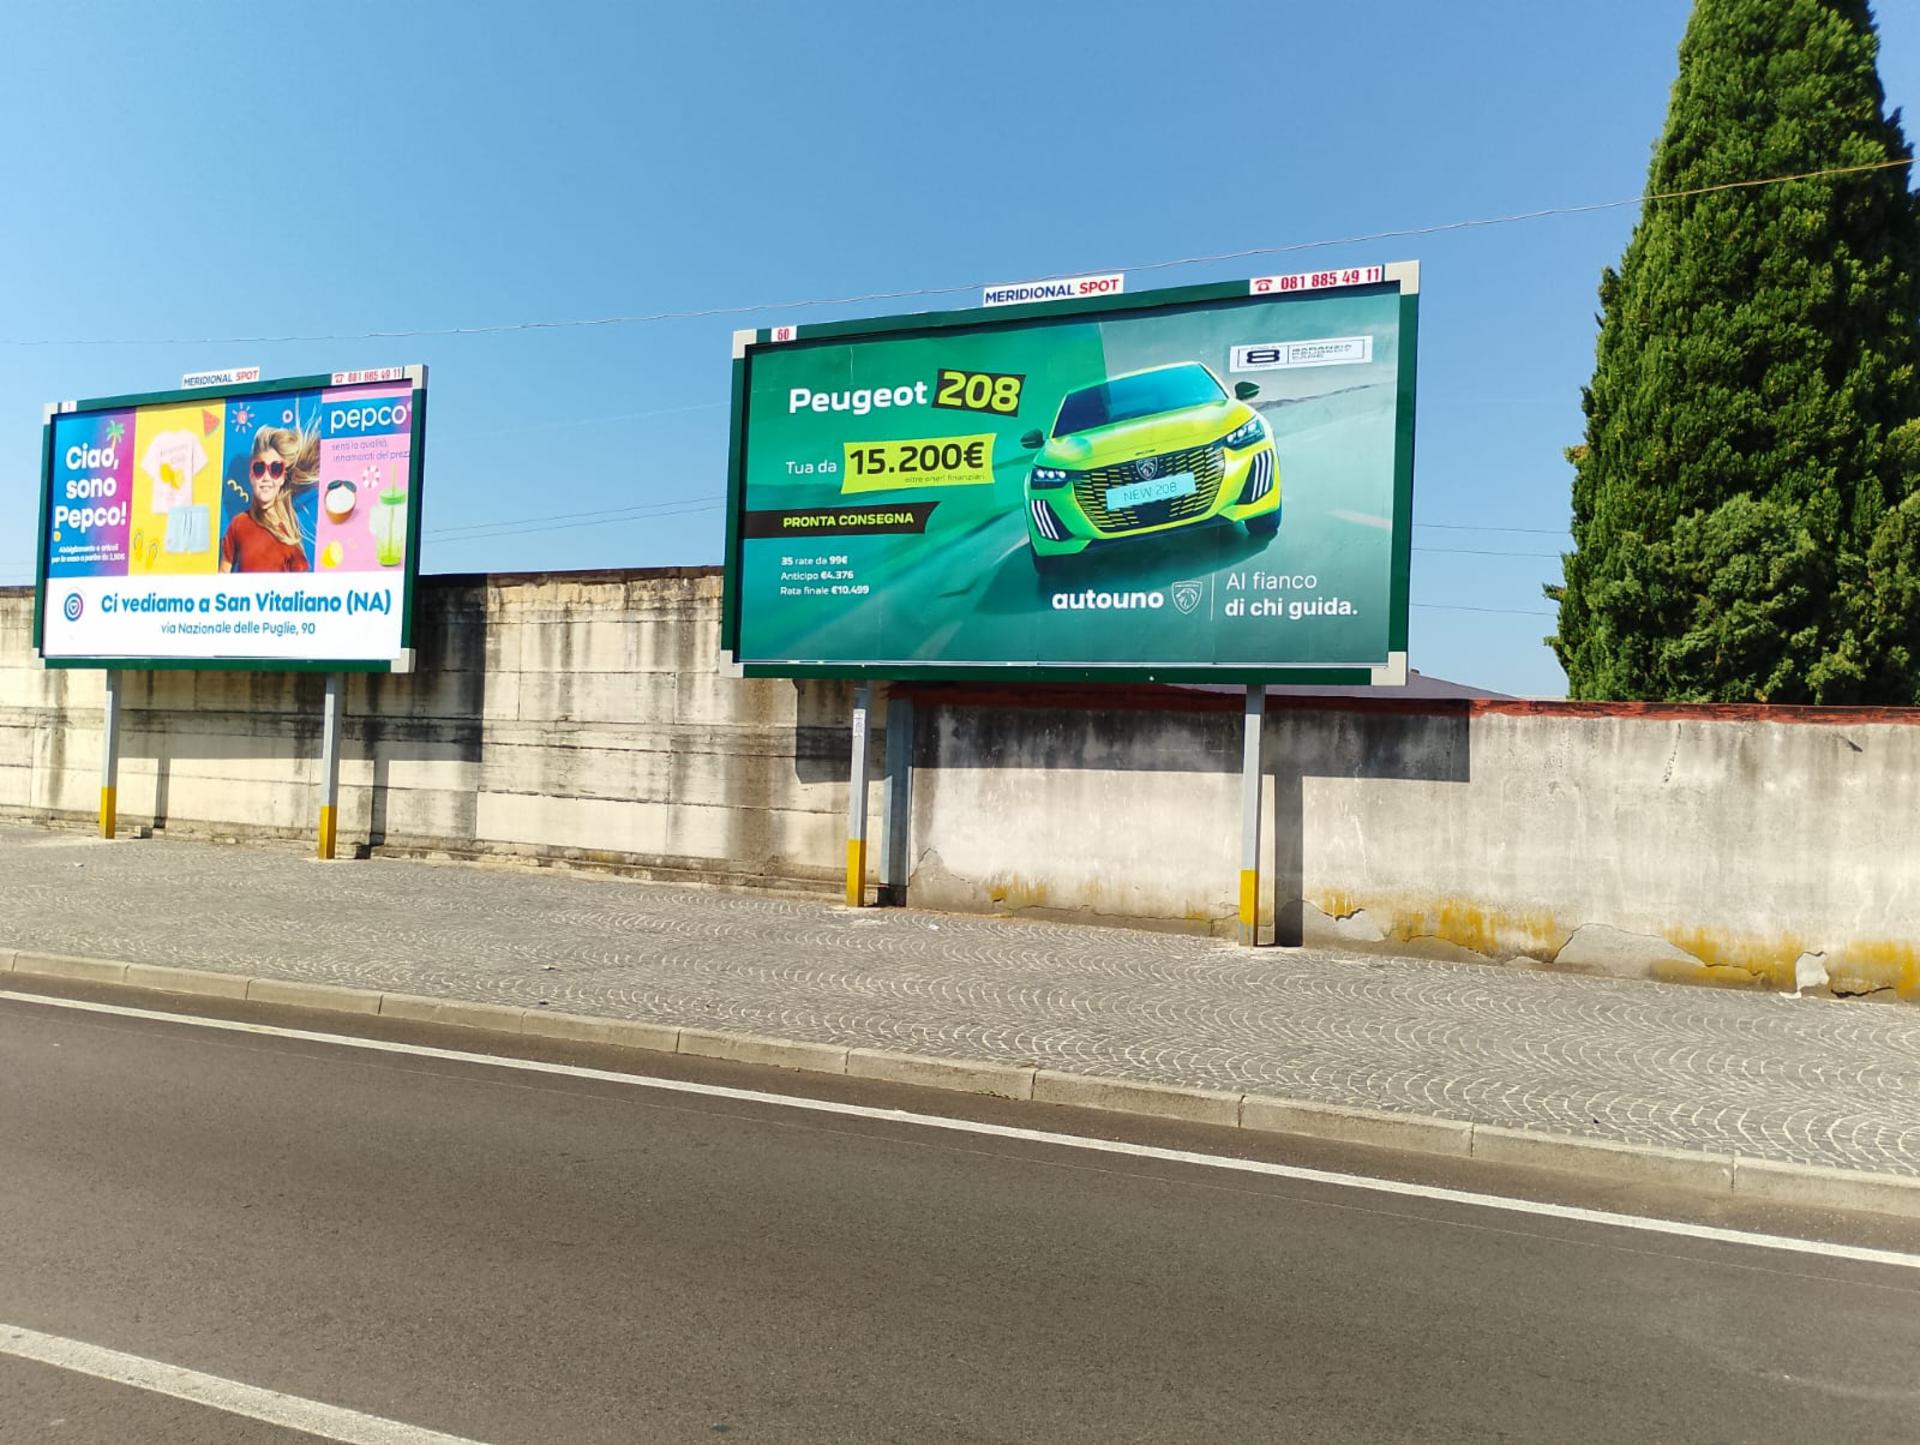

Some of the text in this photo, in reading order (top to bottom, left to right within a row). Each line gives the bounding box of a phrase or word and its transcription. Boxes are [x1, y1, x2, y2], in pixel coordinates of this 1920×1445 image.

[1281, 268, 1379, 290] 081 885 49 11
[985, 279, 1119, 304] MERIDIONAL SPOT
[183, 374, 233, 387] MERIDIONAL
[789, 371, 1021, 416] Peugeot 208
[330, 405, 407, 434] pepco
[66, 442, 119, 471] Ciao,
[786, 441, 985, 475] Tua da 15.200€
[65, 477, 117, 499] sono
[1123, 481, 1177, 502] NEW 208
[54, 501, 127, 534] Pepco!
[783, 512, 914, 528] PRONTA CONSEGNA
[795, 557, 814, 565] rate
[815, 556, 828, 565] da
[780, 571, 819, 581] Anticipo
[1226, 571, 1317, 590] Al fianco
[780, 586, 802, 595] Rata
[804, 585, 829, 595] finale
[1051, 589, 1164, 610] autouno
[101, 589, 391, 615] Ci vediamo a San Vitaliano (NA)
[1225, 596, 1359, 620] di chi guida.
[160, 621, 316, 637] via Nazionale delle Puglie, 90
